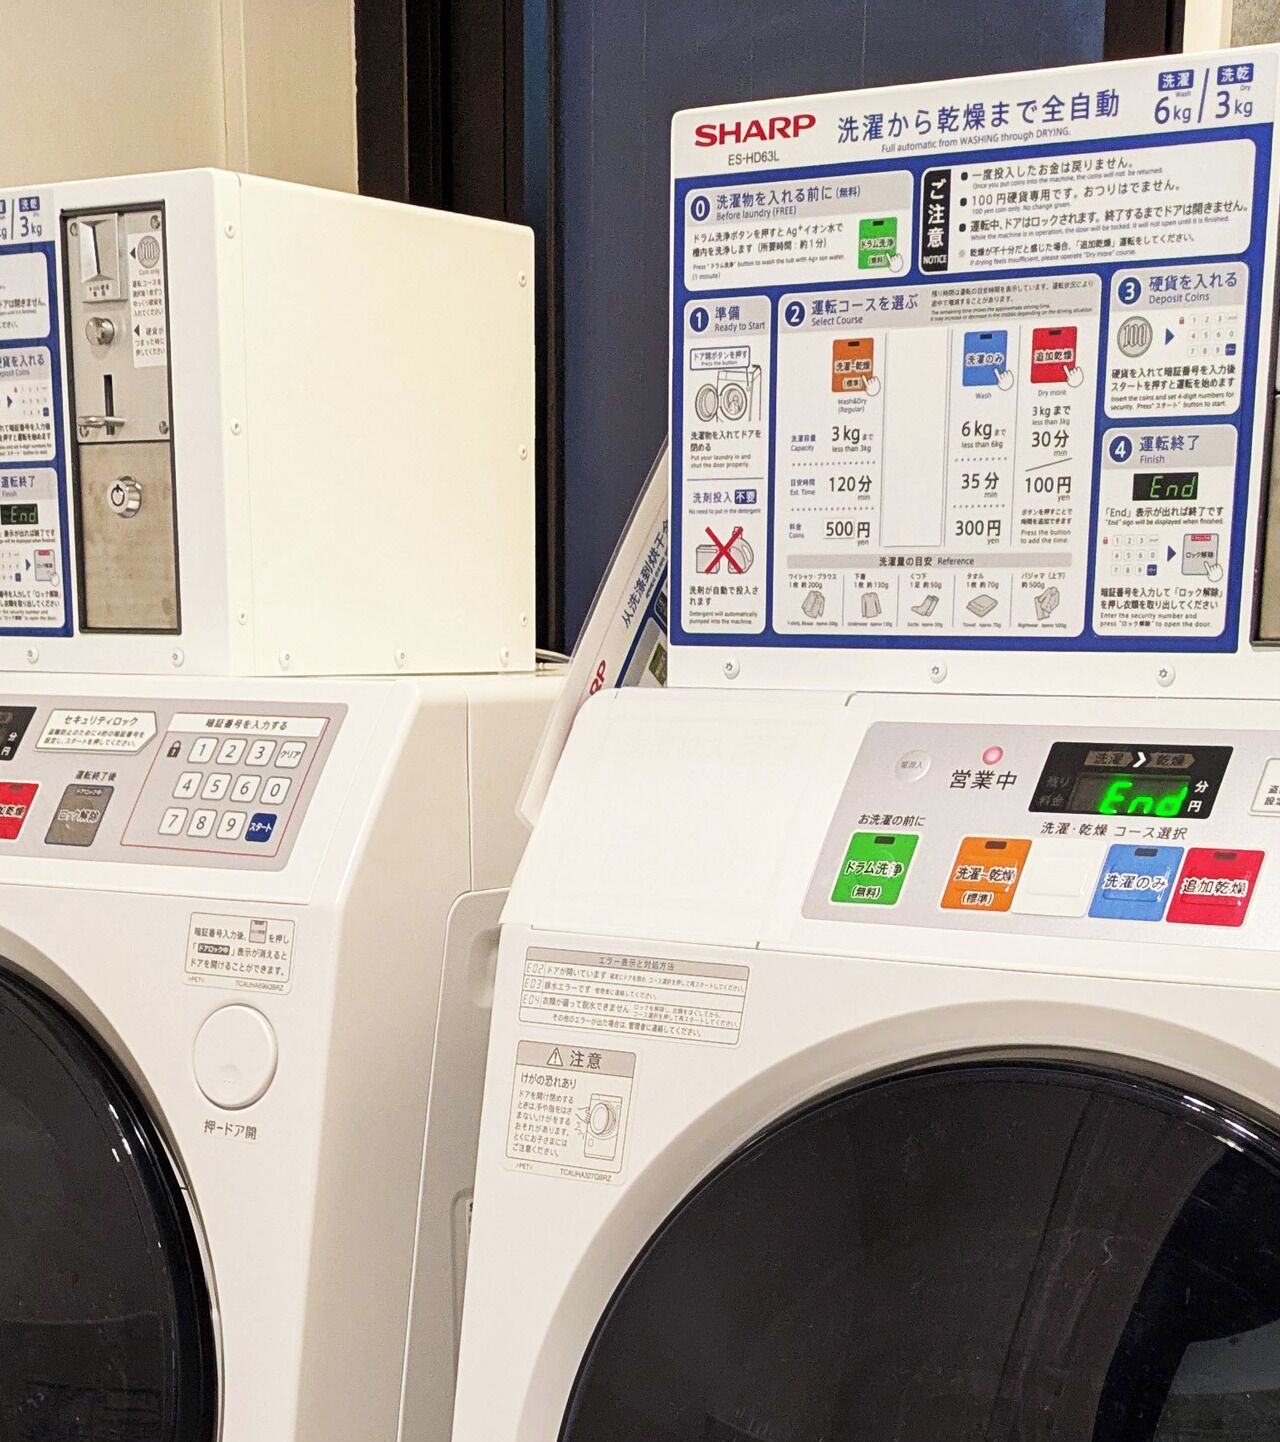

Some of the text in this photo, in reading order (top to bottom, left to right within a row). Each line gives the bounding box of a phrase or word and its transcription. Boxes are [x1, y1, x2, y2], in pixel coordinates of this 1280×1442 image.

[1162, 71, 1190, 88] 洗濯
[1221, 65, 1250, 83] 洗乾
[837, 89, 1120, 144] 洗濯から乾燥まで全自動
[694, 114, 816, 147] SHARP
[881, 126, 1070, 153] Full automatic from WASHING through DRYING.
[728, 150, 780, 166] ES-HD63L
[972, 156, 1133, 180] 一度投入したお金は戻りません。
[716, 187, 832, 210] 洗濯物を入れる前に
[716, 205, 797, 222] Before laundry (FREE)
[927, 177, 946, 248] ご注意
[922, 254, 947, 265] NOTICE
[1125, 272, 1237, 300] 3 硬貨を入れる
[1149, 292, 1210, 305] Deposit Coins
[791, 306, 800, 323] 2
[811, 293, 918, 315] 運転コースを選ぶ
[695, 306, 740, 329] 1 準備
[811, 315, 863, 326] Select Course
[714, 320, 765, 333] Ready to Start
[967, 355, 1002, 364] 洗濯のみ
[1036, 352, 1072, 362] 追加乾燥
[1112, 364, 1236, 379] 硬貨を入れて暗証番号を入力後
[1111, 378, 1235, 392] スタートを押すと運転を始めます
[1115, 435, 1200, 458] 4 運転終了
[1140, 455, 1165, 464] Finish
[1, 475, 36, 488] 運転終了
[1150, 476, 1195, 498] End
[693, 492, 732, 504] 洗剤投入
[10, 507, 38, 522] End
[879, 556, 974, 567] 洗濯量の目安 Reference
[1100, 600, 1218, 610] を押し衣類を取り出してください
[64, 715, 138, 727] セキュリティロック
[205, 718, 288, 731] 暗証番号を入力する
[949, 769, 1018, 791] 営業中
[1194, 780, 1209, 793] 分
[1099, 780, 1188, 816] End
[1188, 800, 1202, 813] 円
[249, 822, 272, 834] スタート
[858, 813, 926, 827] お洗濯の前に
[1040, 821, 1188, 840] 洗濯・乾燥 コース選択
[846, 860, 902, 877] ドラム洗浄
[1104, 873, 1168, 890] 洗濯のみ
[1182, 879, 1246, 896] 追加乾燥
[190, 959, 286, 977] ドアを開けることができます。
[570, 1051, 602, 1070] 注意
[521, 1072, 576, 1089] けがの恐れあり
[204, 1120, 258, 1140] 押ードア開
